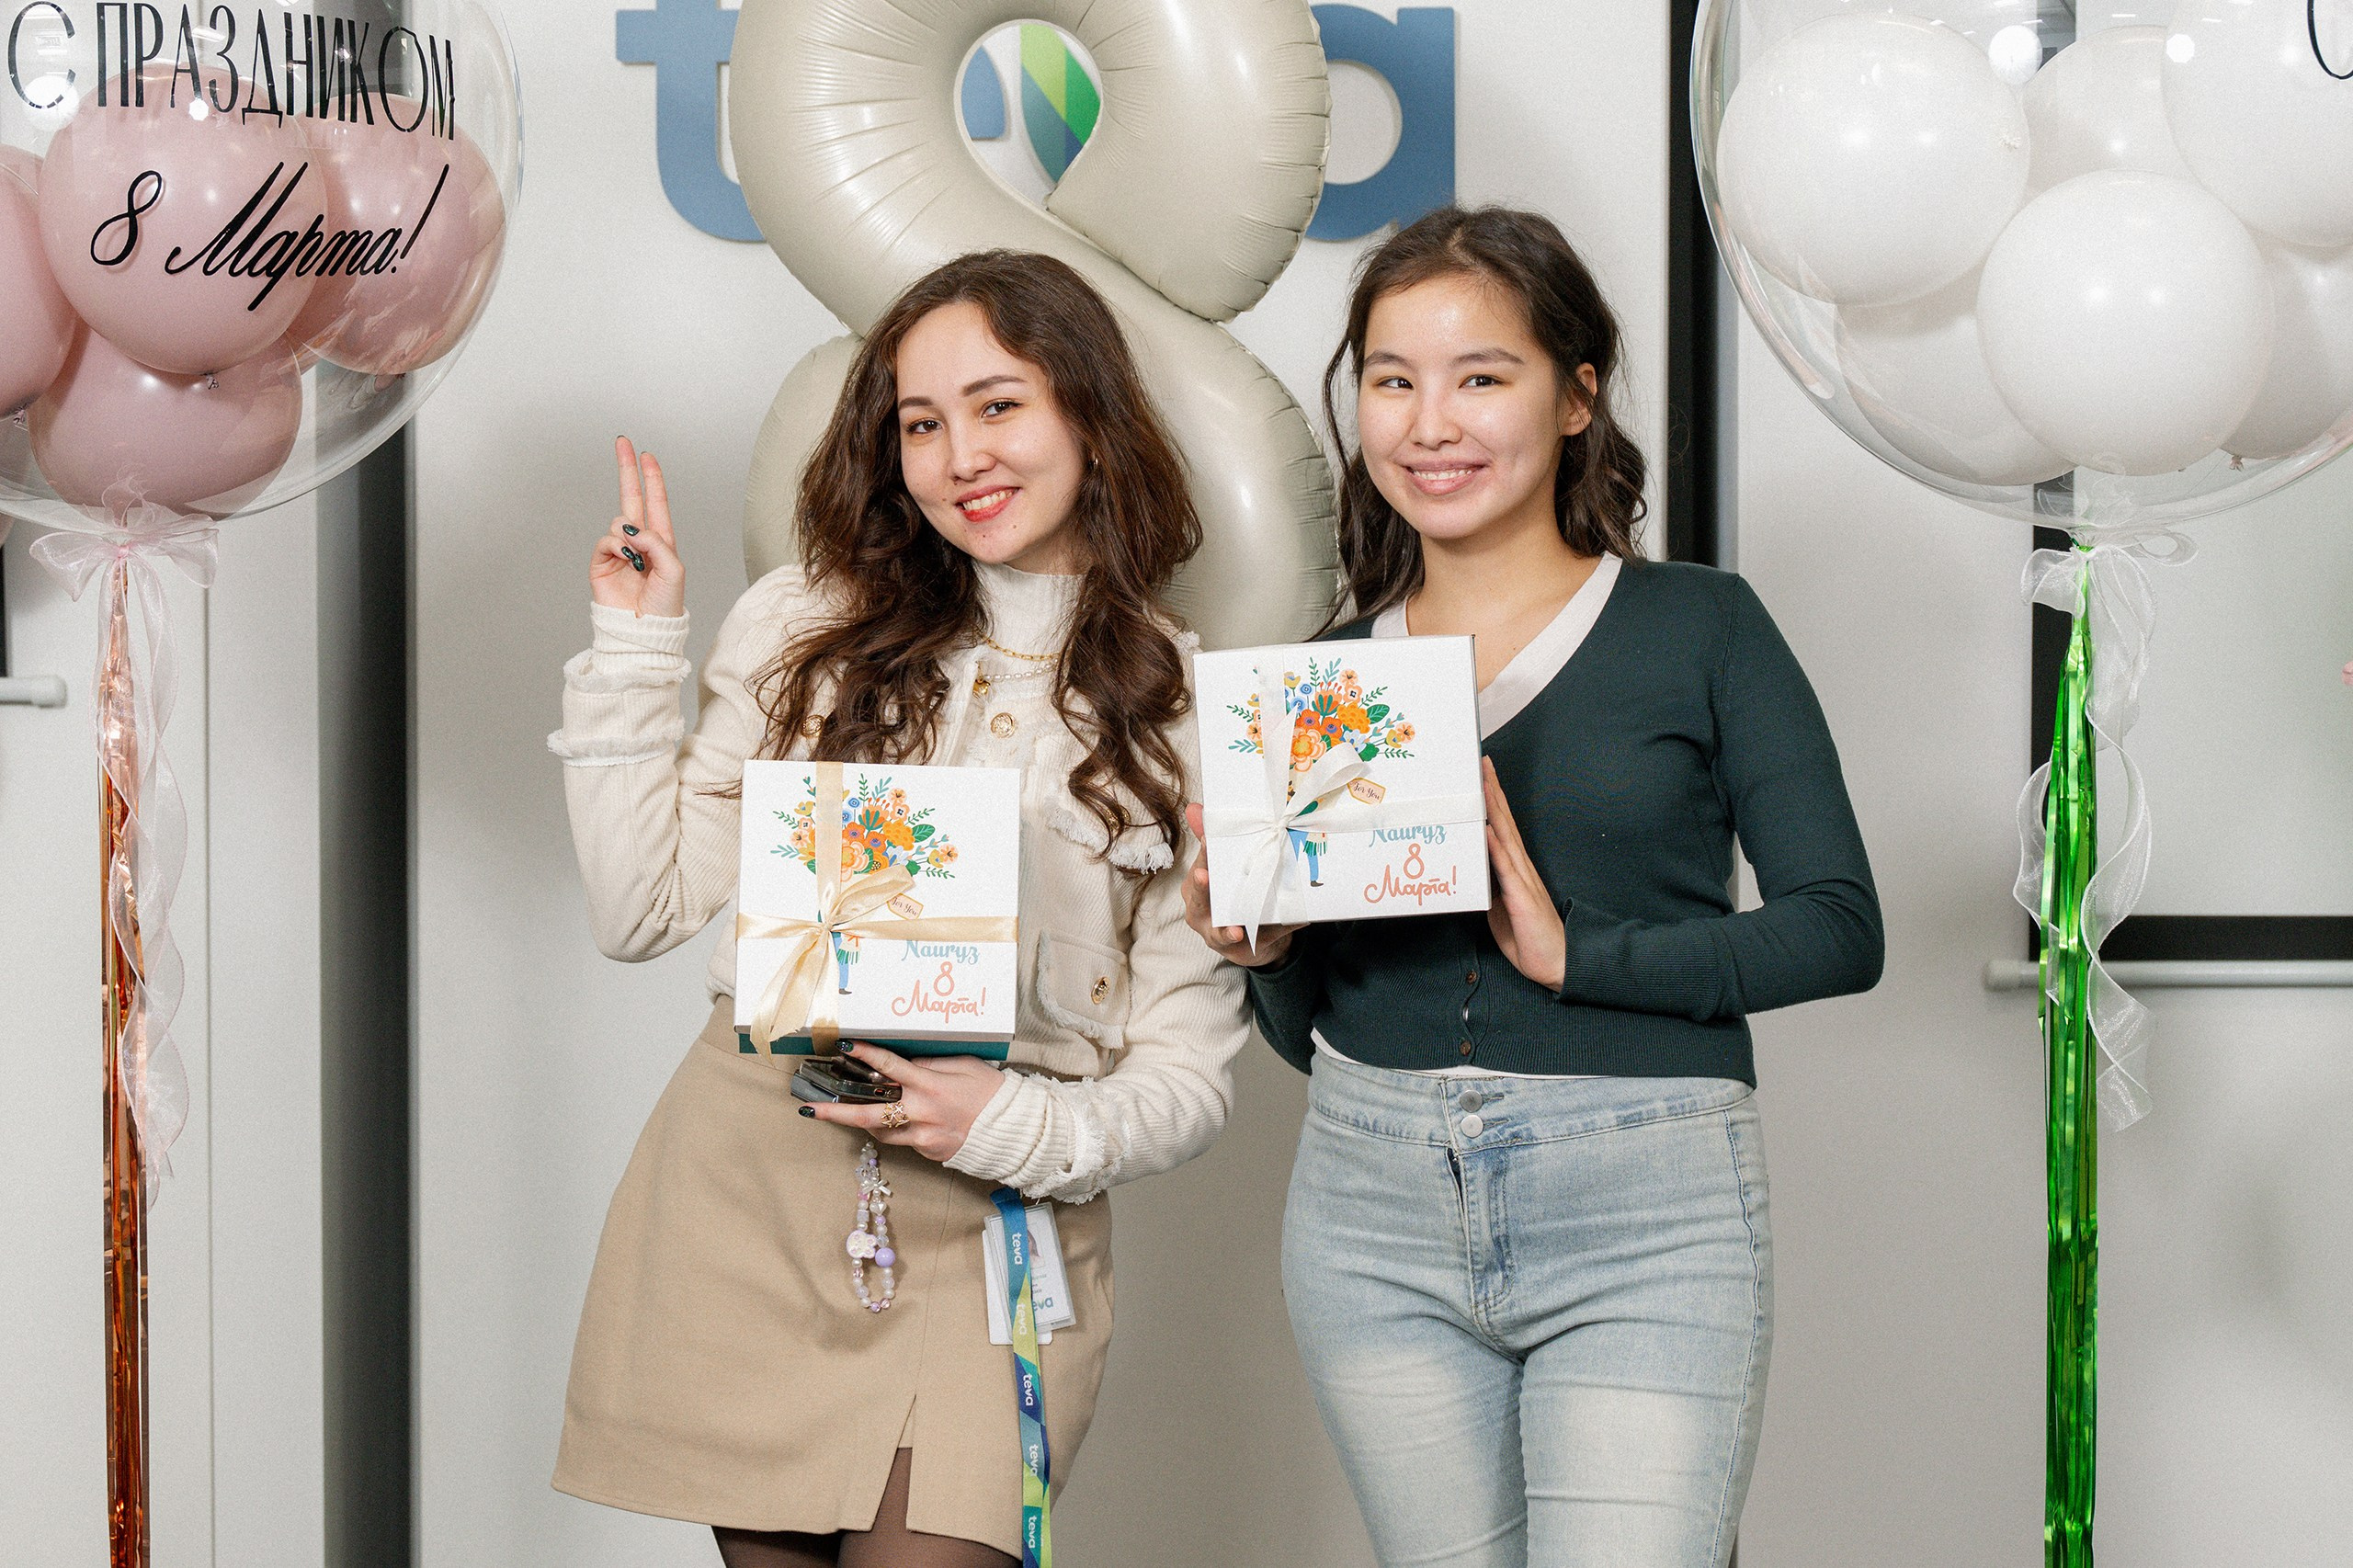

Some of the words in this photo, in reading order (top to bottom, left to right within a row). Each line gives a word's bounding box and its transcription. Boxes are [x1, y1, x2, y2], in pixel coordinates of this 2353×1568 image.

[8, 1, 75, 108] С
[96, 2, 456, 140] ПРАЗДНИКОМ
[616, 0, 1456, 243] ta
[90, 170, 164, 267] 8
[165, 162, 449, 311] Марта!
[1369, 824, 1447, 847] Nauryz
[1403, 843, 1425, 880] 8
[1363, 864, 1457, 906] Марта!
[901, 938, 980, 965] Nauryz
[933, 960, 955, 996] 8
[891, 979, 986, 1024] Марта!
[1012, 1232, 1023, 1265] teva
[1016, 1303, 1028, 1335] teva
[1031, 1297, 1054, 1312] eva
[1023, 1373, 1034, 1406] teva
[1029, 1444, 1040, 1477] teva
[1028, 1515, 1038, 1549] teva
